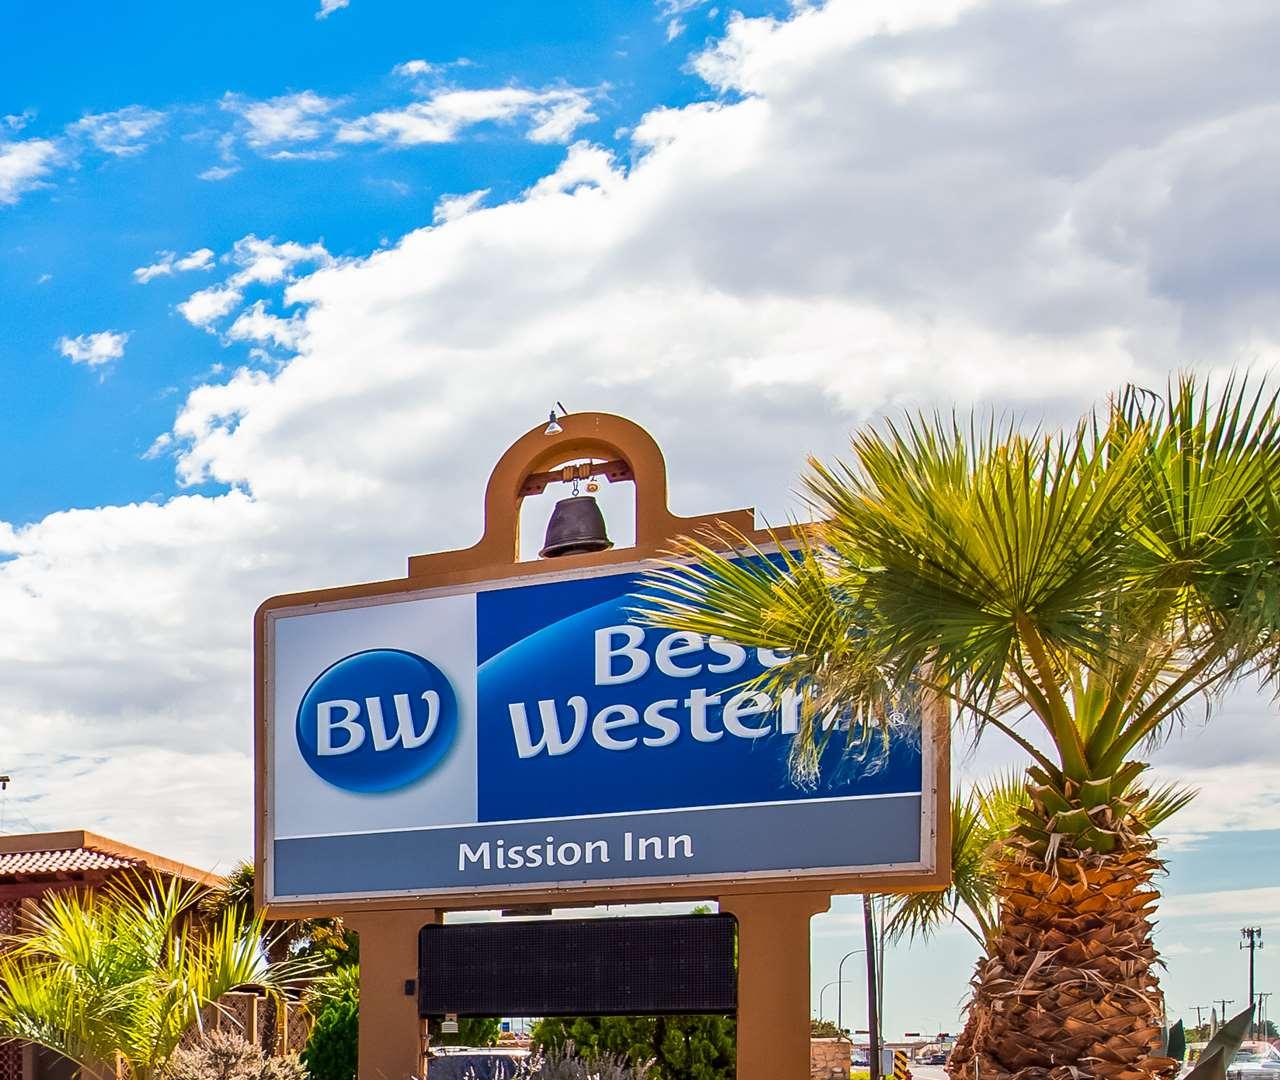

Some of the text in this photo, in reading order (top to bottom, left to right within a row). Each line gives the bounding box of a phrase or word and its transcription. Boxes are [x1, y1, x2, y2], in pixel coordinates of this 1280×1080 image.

[317, 690, 440, 756] BW
[459, 832, 694, 871] Mission Inn
